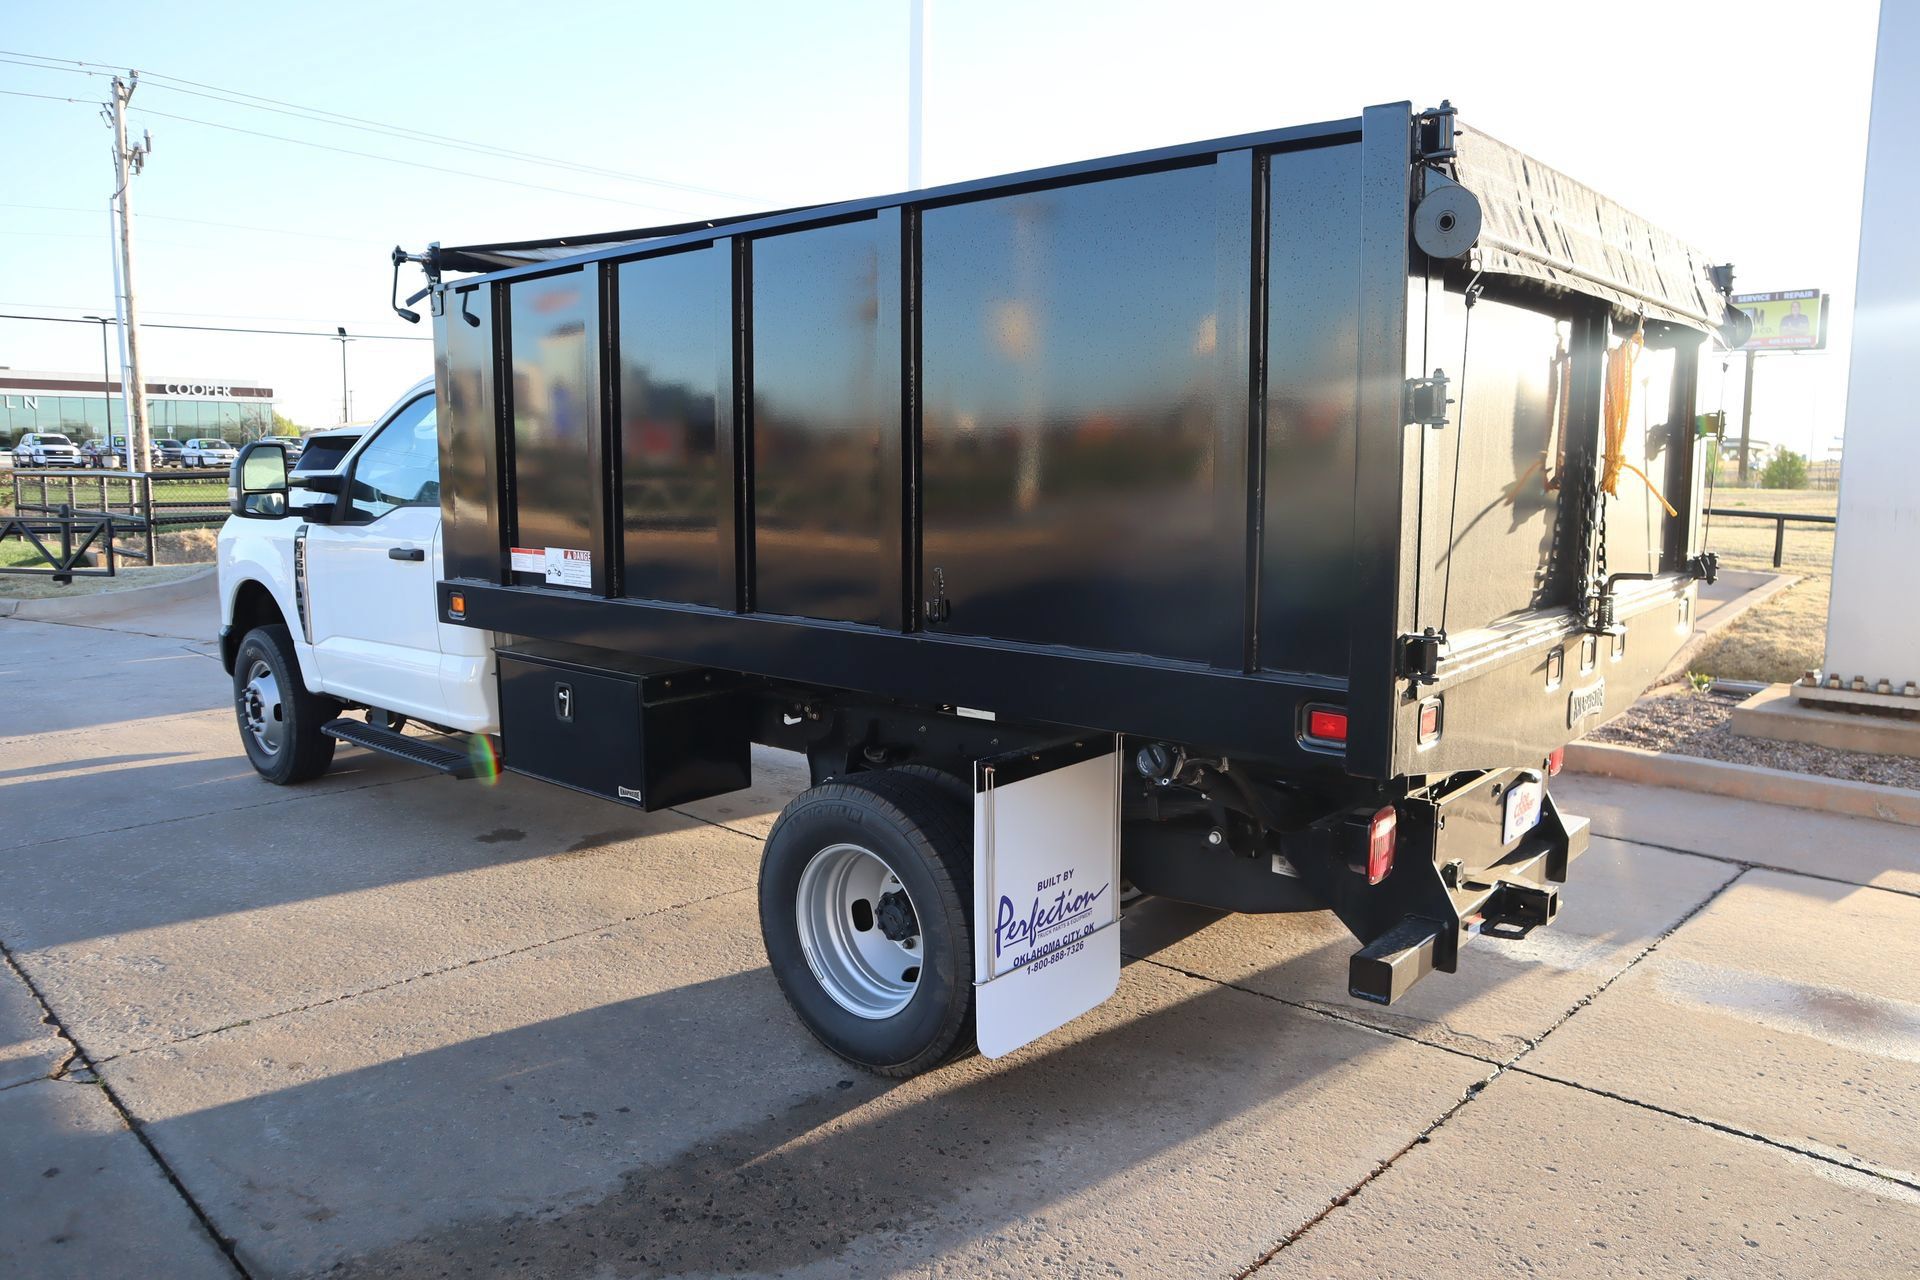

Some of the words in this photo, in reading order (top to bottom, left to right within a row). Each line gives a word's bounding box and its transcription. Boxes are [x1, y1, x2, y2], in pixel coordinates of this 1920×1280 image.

[1737, 293, 1770, 303] SERVICE
[1783, 290, 1814, 300] REPAIR
[165, 384, 232, 398] COOPER
[1037, 873, 1062, 892] BUILT
[1063, 868, 1074, 882] BY
[995, 882, 1109, 958] Perfection
[1037, 930, 1052, 940] TRUCK
[1052, 923, 1067, 934] PARTS
[1070, 910, 1093, 925] EQUIPMENT
[1013, 939, 1061, 968] OKLAHOMA
[1083, 922, 1095, 936] OK
[1026, 940, 1084, 975] 1-800-888-7326
